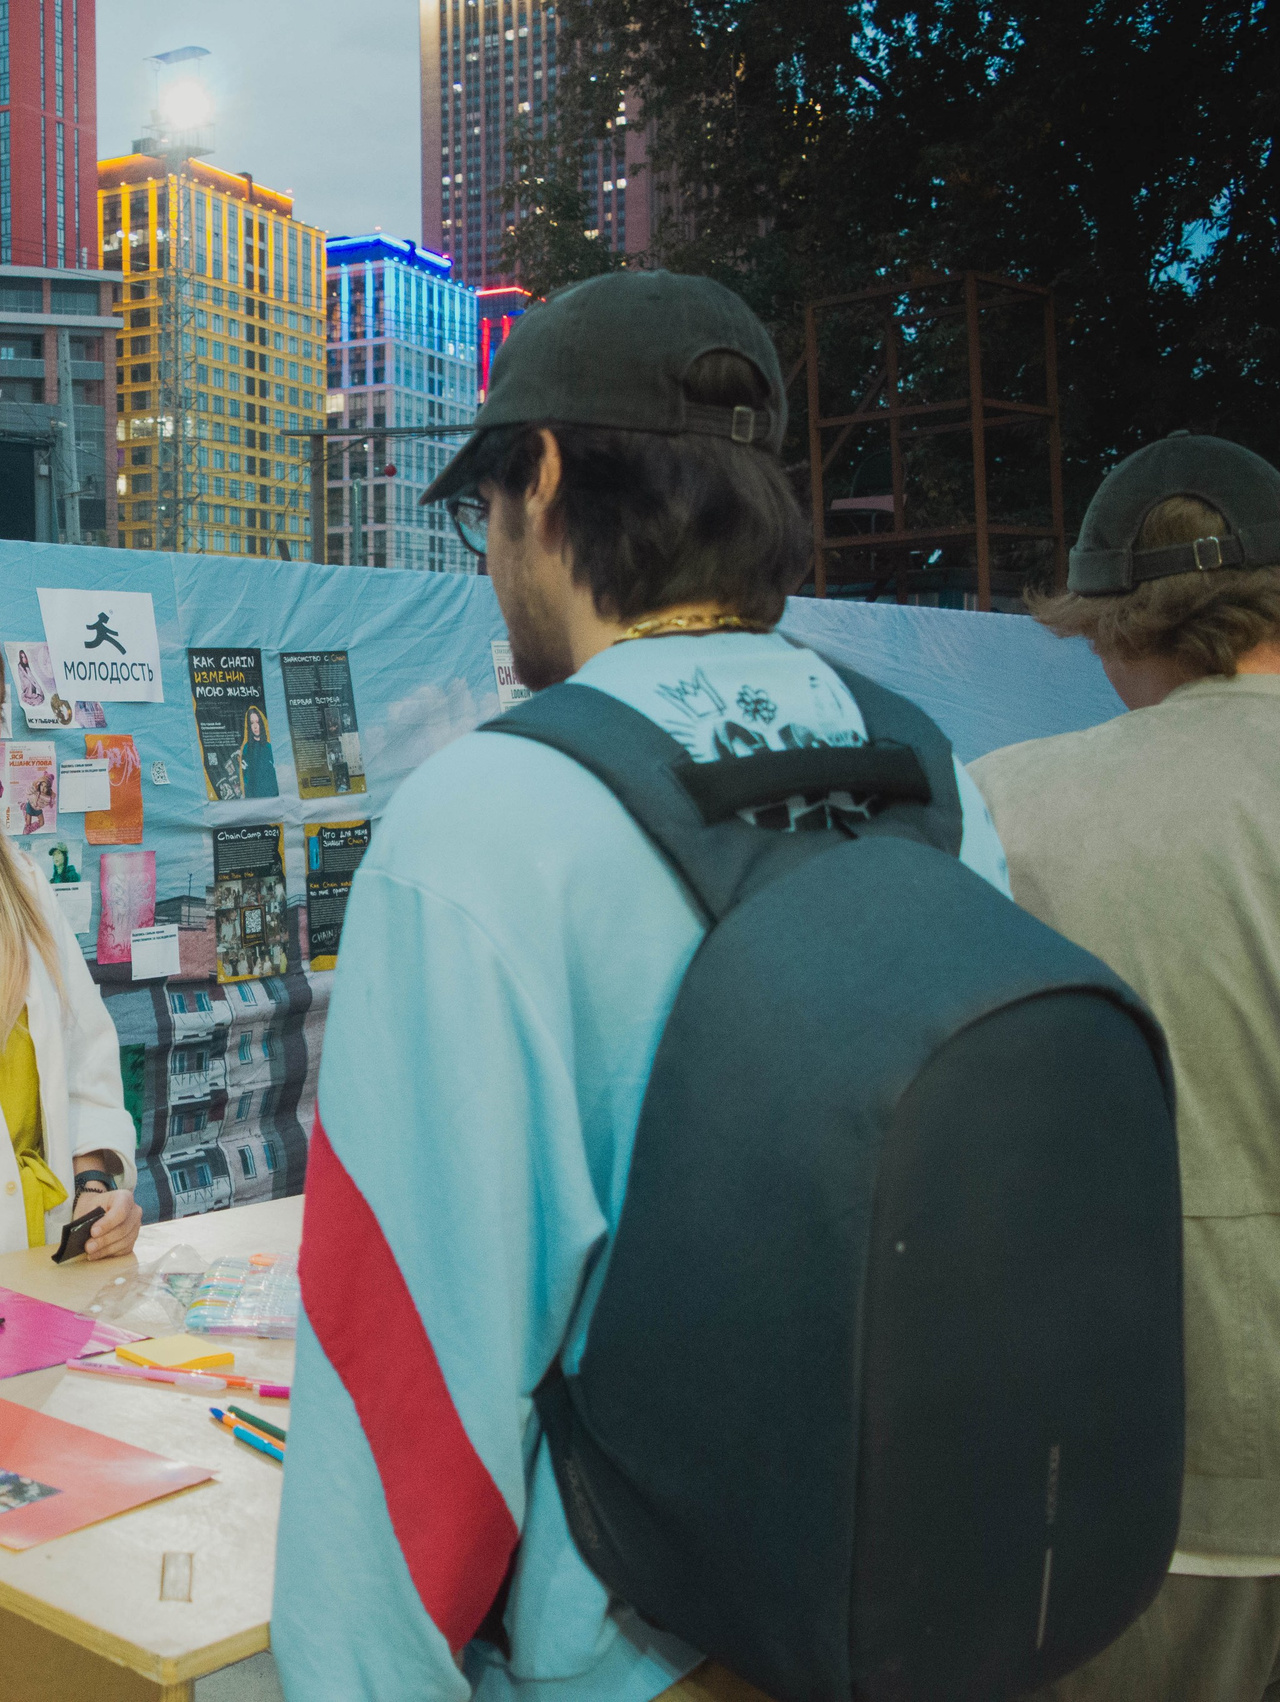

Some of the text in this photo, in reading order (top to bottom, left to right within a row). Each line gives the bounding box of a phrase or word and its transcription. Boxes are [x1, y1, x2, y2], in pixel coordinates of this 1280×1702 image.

[192, 655, 255, 669] КАК CHAIN
[63, 660, 154, 685] МОЛОДОСТЬ
[193, 671, 246, 684] ИЗМЕНИЛ
[195, 686, 224, 699] МОЮ
